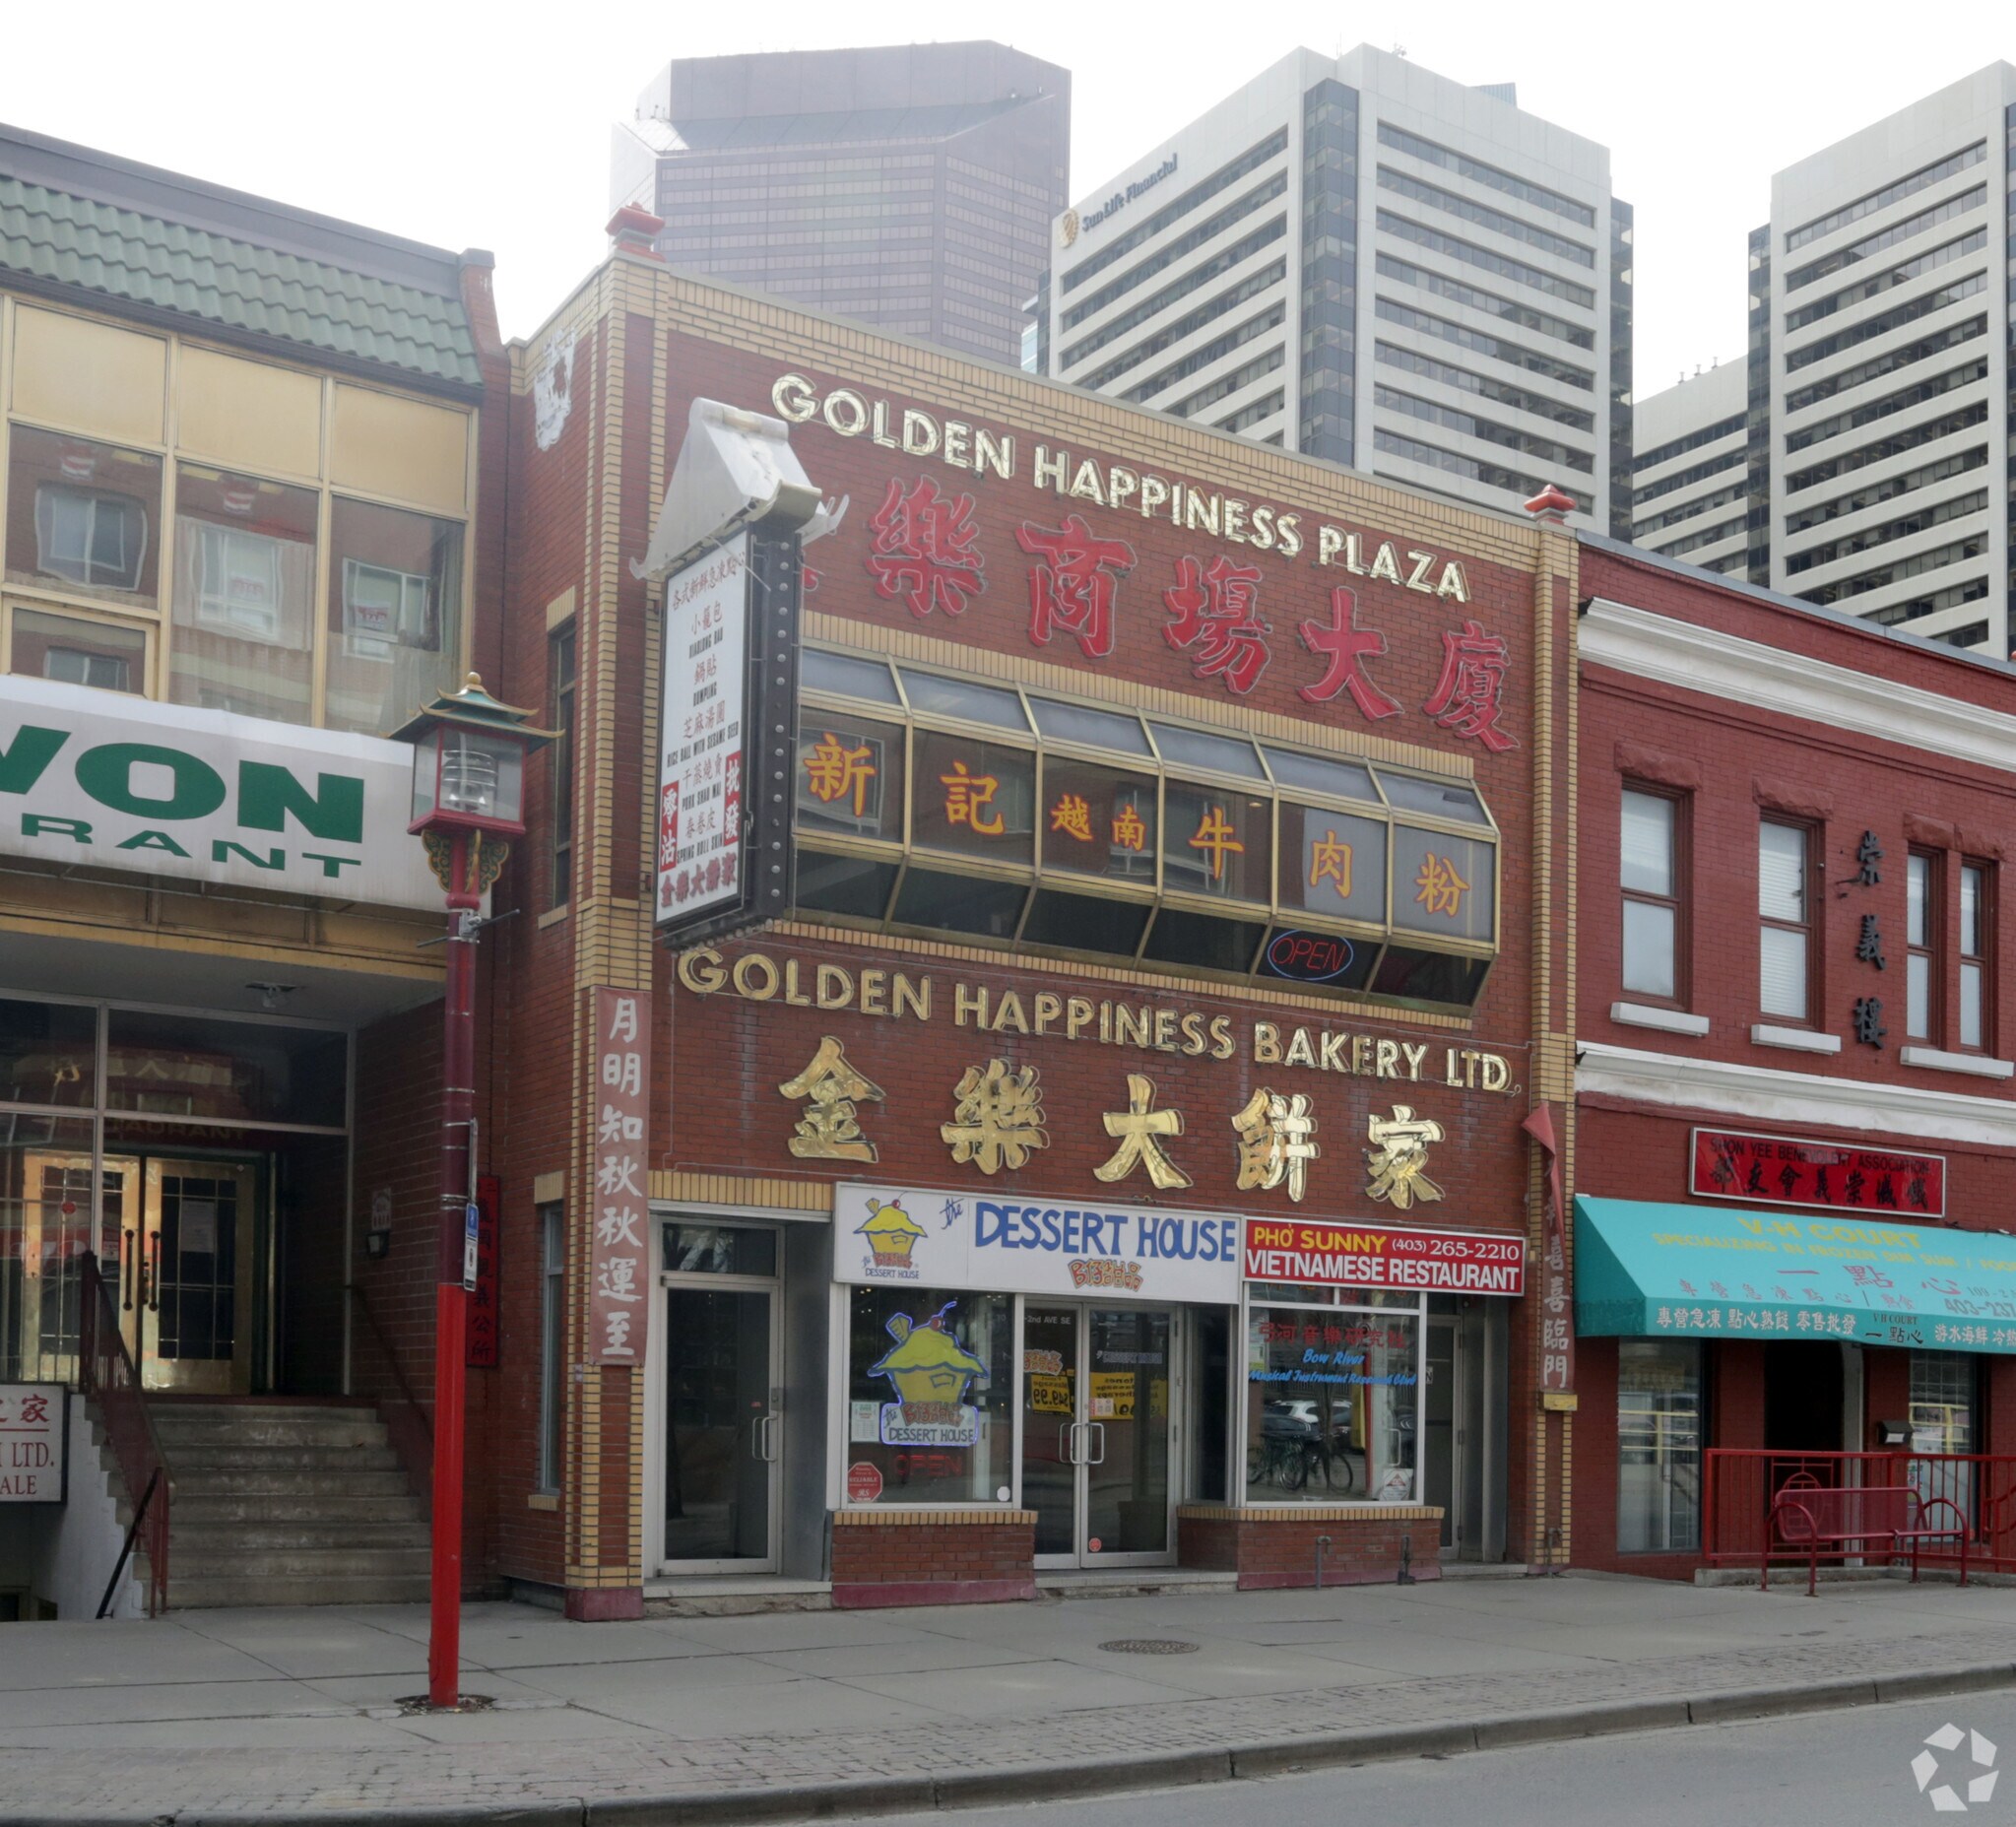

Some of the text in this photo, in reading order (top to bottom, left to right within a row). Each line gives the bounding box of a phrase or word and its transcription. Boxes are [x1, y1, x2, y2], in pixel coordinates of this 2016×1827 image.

[1082, 153, 1178, 232] Sun Life Financial
[771, 371, 1471, 603] GOLDEN HAPPINESS PLAZA
[667, 750, 679, 768] RICE
[693, 740, 705, 756] WITH
[803, 732, 1470, 917] 新記越南牛肉粉
[22, 813, 362, 879] RANT
[1271, 936, 1348, 972] OPEN
[678, 945, 932, 1021] GOLDEN
[954, 983, 1236, 1061] HAPPINESS
[1254, 1020, 1428, 1082] BAKERY
[777, 1035, 1447, 1210] 金樂大餅家
[1711, 1138, 1930, 1174] SHON YEE BENEVOLENT ASSOCIATION
[596, 997, 644, 1357] 月明知秋秋運至
[939, 1197, 1237, 1263] the DESSERT HOUSE
[1808, 1223, 1922, 1249] COURT
[1300, 1230, 1388, 1254] SUNNY
[1392, 1237, 1427, 1254] (403)
[1429, 1239, 1520, 1261] 265-2210
[865, 1268, 920, 1280] DESSERT HOUSE
[1246, 1248, 1521, 1291] VIETNAMESE RESTAURANT
[1777, 1265, 1962, 1295] 一點心
[1657, 1306, 1722, 1329] 專營急凍
[1796, 1310, 1856, 1335] 零售批發
[1889, 1315, 1918, 1325] COURT
[1865, 1327, 1923, 1344] 一點心
[1302, 1347, 1365, 1366] Bow River
[1249, 1369, 1291, 1383] Musical
[0, 1393, 50, 1423] 家
[889, 1427, 974, 1443] DESSERT HOUSE
[12, 1441, 54, 1468] LTD.
[894, 1454, 962, 1476] OPEN
[0, 1475, 37, 1495] ALE
